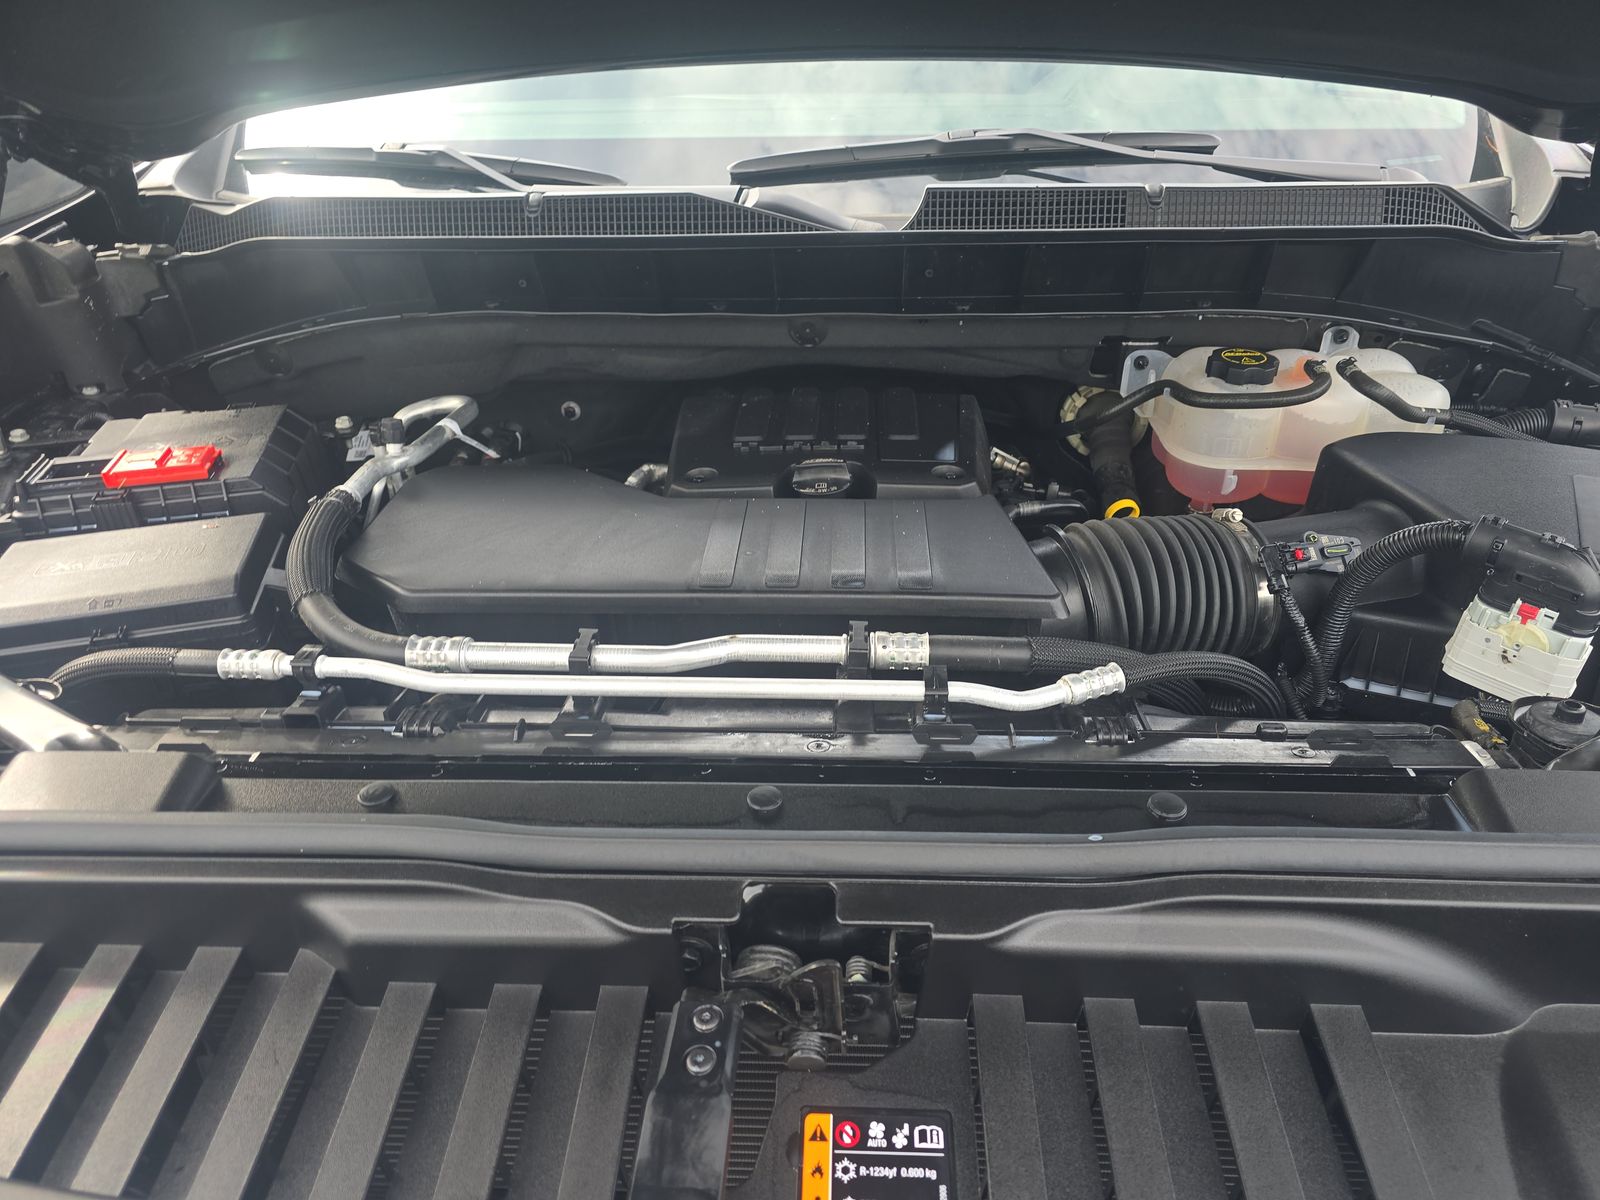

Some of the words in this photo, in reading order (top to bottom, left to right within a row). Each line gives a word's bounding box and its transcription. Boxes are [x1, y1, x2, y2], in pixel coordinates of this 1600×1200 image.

[867, 1138, 887, 1148] AUTO
[859, 1165, 897, 1179] R-1234yf
[925, 1167, 937, 1180] kg
